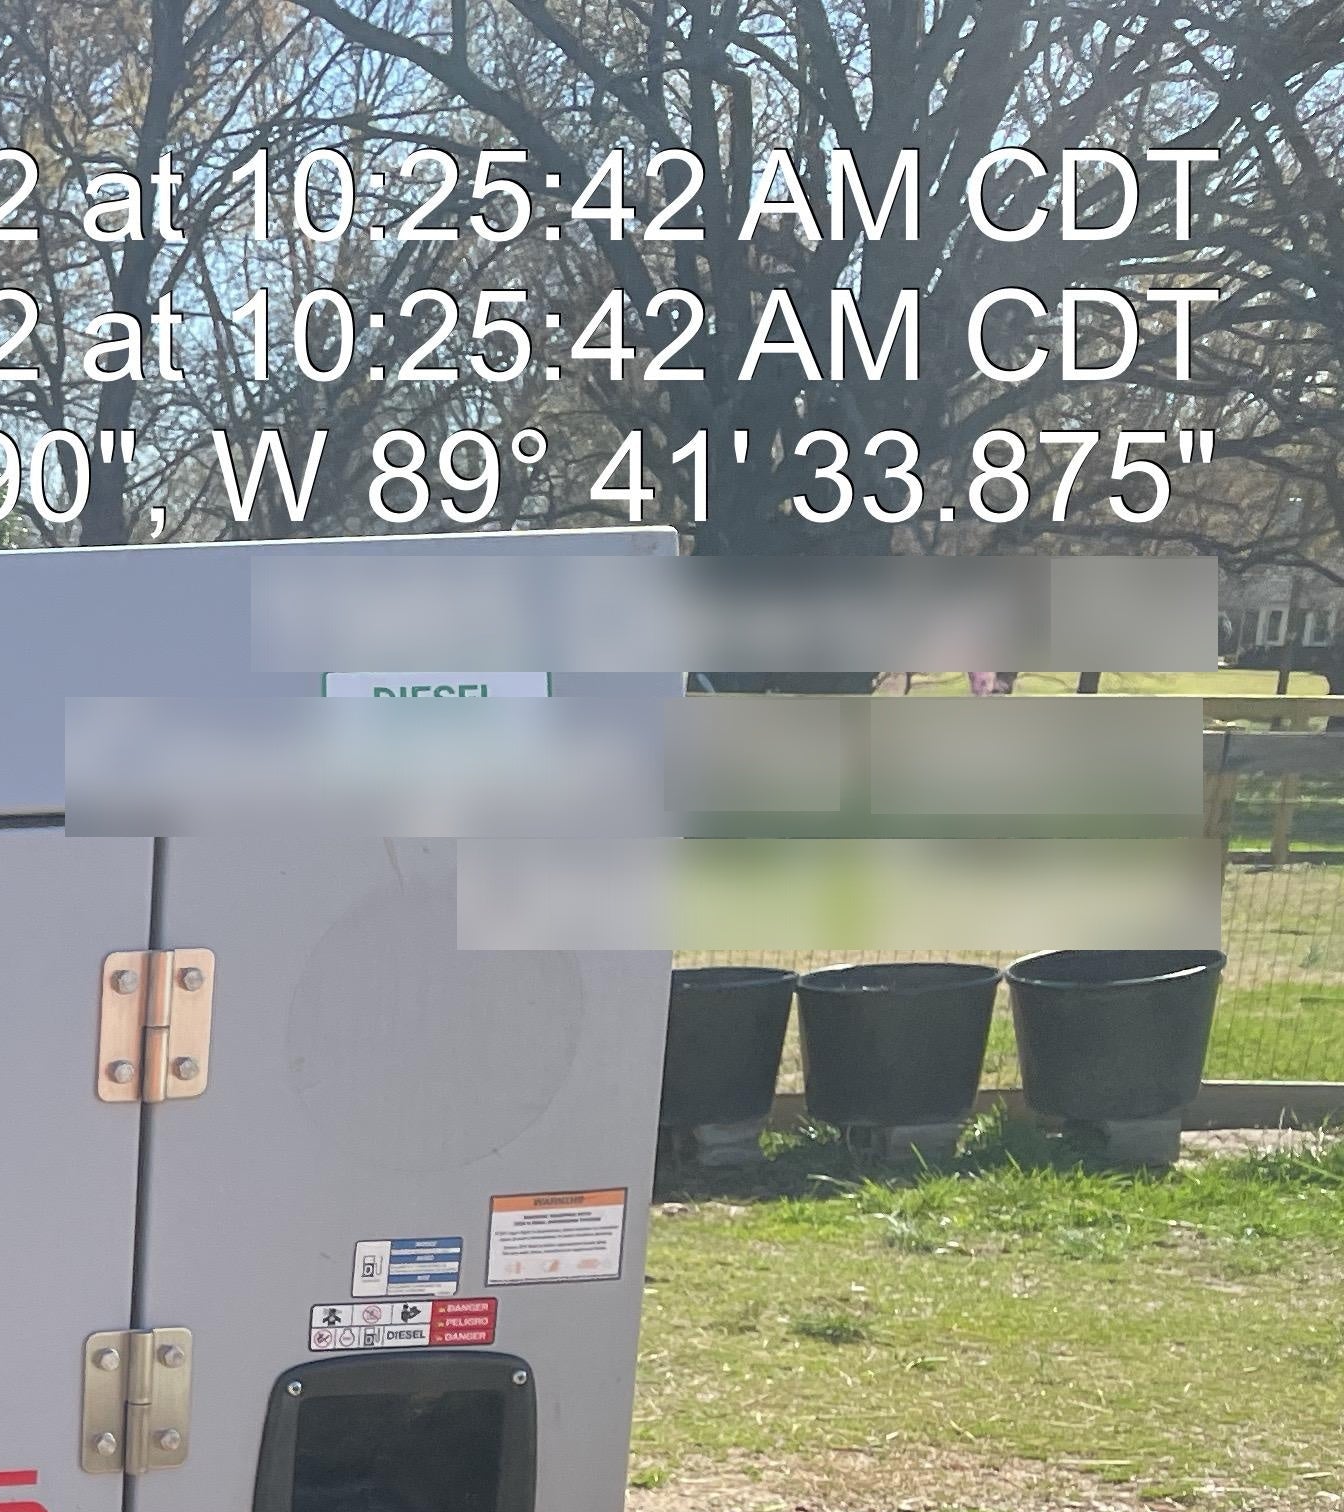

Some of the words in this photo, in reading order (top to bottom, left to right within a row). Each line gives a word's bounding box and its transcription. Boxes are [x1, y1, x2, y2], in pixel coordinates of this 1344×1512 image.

[446, 1303, 489, 1313] DANGER
[445, 1317, 489, 1327] PELIGRO
[386, 1330, 426, 1340] DIESEL
[444, 1332, 486, 1341] DANGER
